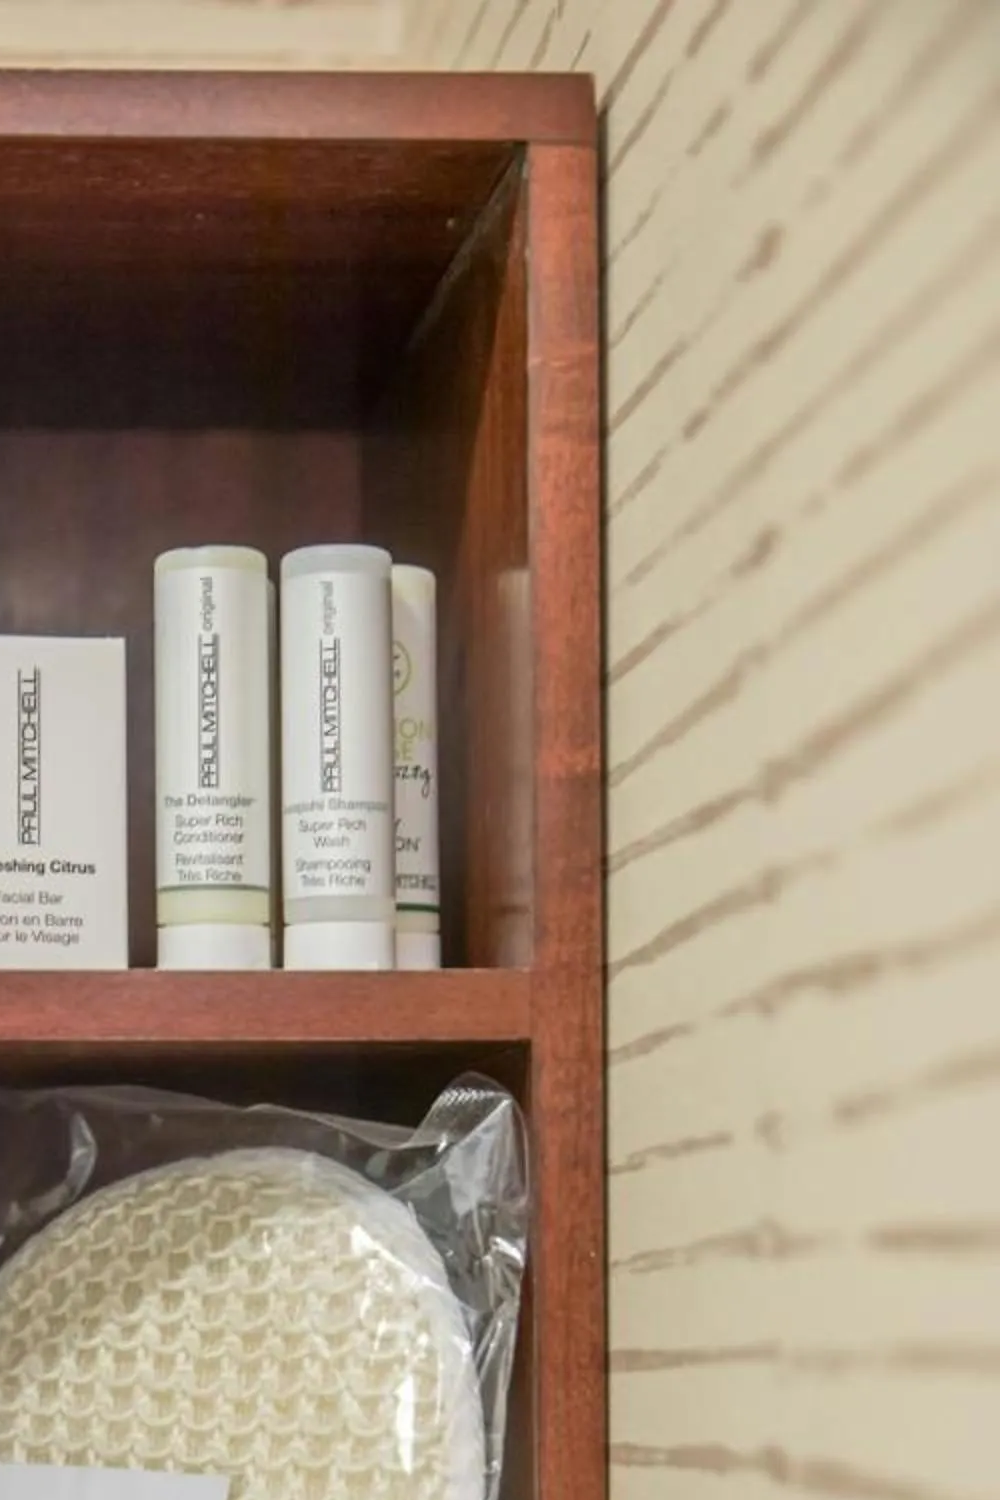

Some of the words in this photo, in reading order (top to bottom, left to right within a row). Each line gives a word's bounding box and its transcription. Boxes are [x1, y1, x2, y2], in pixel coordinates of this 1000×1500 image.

[200, 633, 218, 733] MITCHELL
[321, 637, 339, 737] MITCHELL
[20, 666, 39, 781] MITCHELL
[200, 735, 218, 788] PAUL
[322, 740, 340, 793] PAUL
[20, 785, 39, 845] PAUL
[215, 813, 243, 827] Rich
[173, 831, 244, 845] Conditioner
[49, 859, 96, 875] Citrus
[38, 890, 64, 905] Bar
[22, 915, 40, 926] en
[44, 913, 84, 927] Barre
[15, 930, 28, 943] le
[31, 930, 80, 947] Visage
